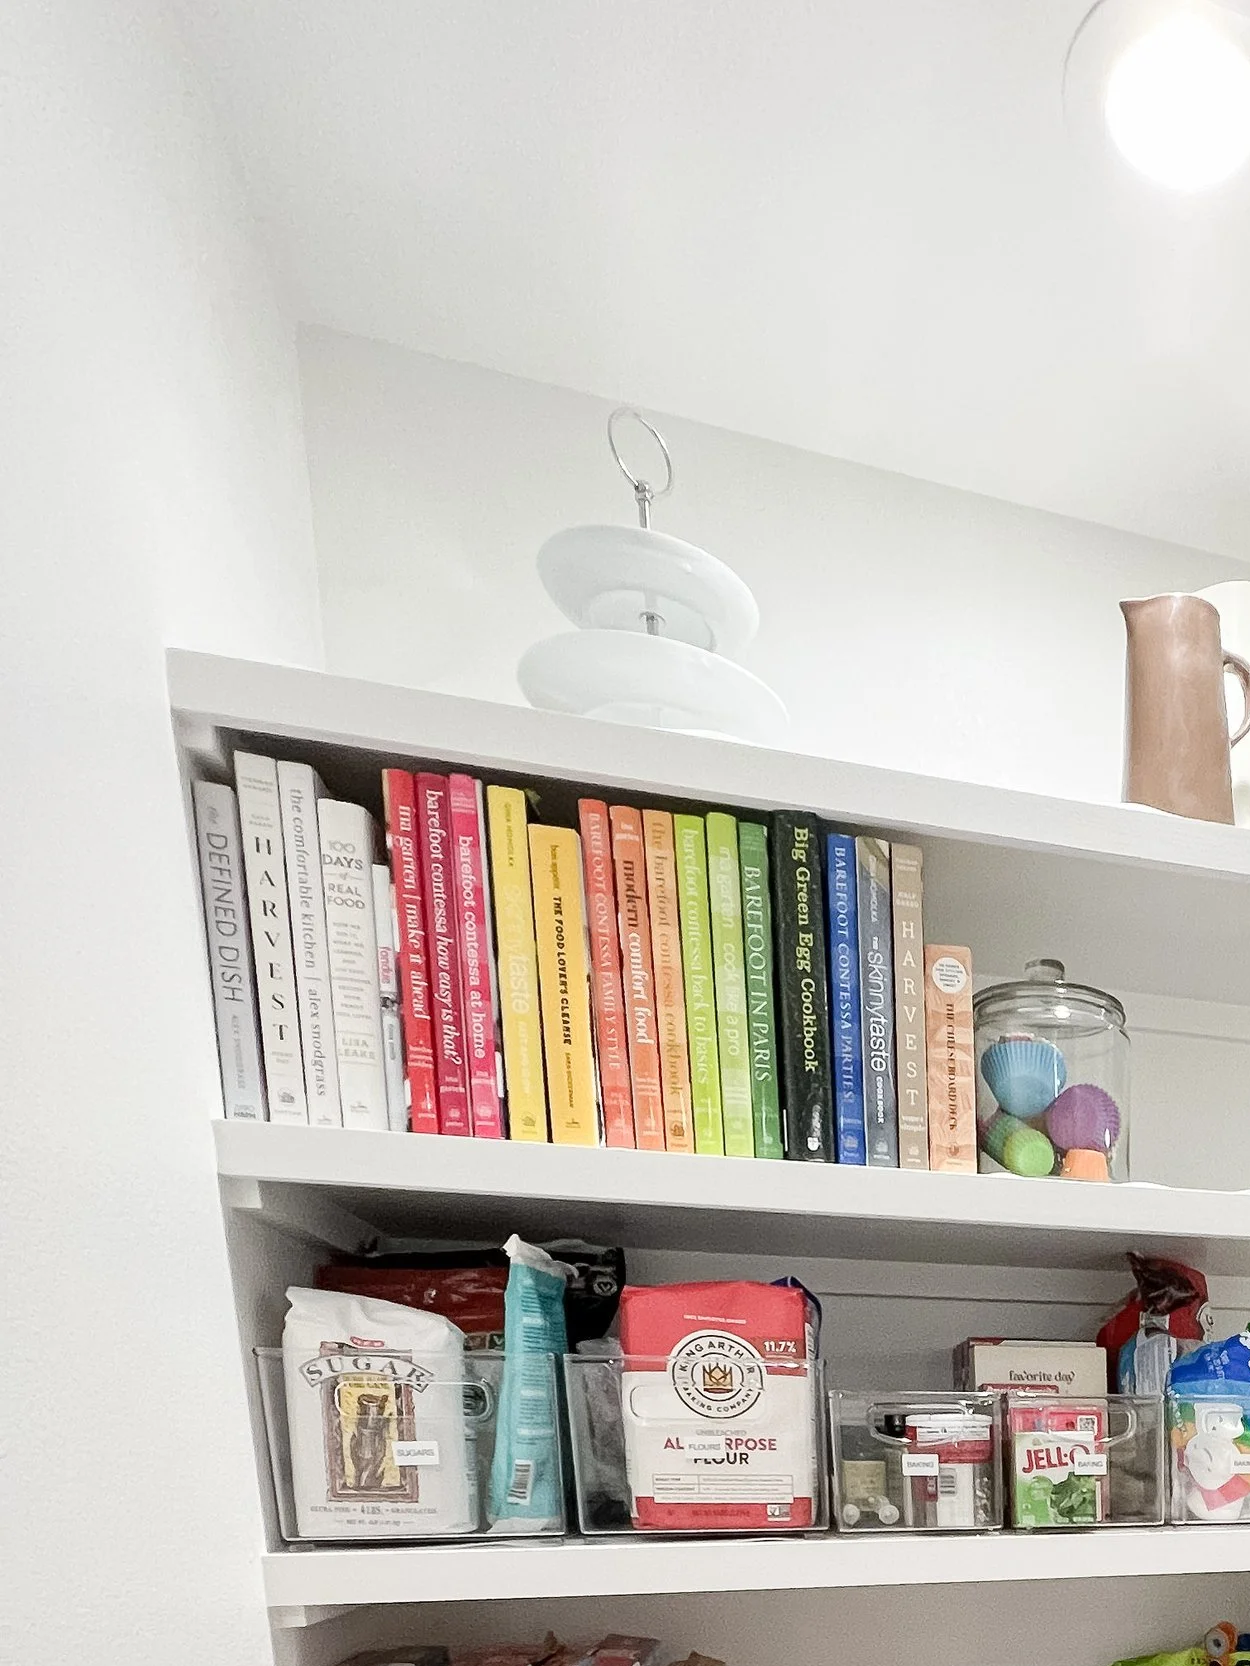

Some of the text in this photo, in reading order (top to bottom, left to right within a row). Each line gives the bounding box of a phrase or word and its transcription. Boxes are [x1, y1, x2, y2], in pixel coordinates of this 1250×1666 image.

[322, 854, 364, 871] DAYS
[589, 813, 608, 892] BAREFOOT
[681, 828, 702, 898] barefoot
[206, 832, 238, 938] DEFINED
[327, 895, 365, 910] FOOD
[328, 882, 362, 898] REAL
[552, 896, 562, 915] THE
[716, 873, 736, 929] garten
[833, 847, 850, 939] BAREFOOT
[289, 788, 327, 1096] the comfortable kitchen alex snodgrass
[404, 902, 426, 949] make
[425, 788, 463, 1066] barefoot contessa how easy is that?
[457, 835, 487, 1059] barefoot contessa at home
[554, 916, 566, 949] FOOD
[594, 894, 613, 968] CONTESSA
[686, 901, 704, 972] contessa
[791, 826, 819, 1073] Big Green Egg Cookbook
[218, 945, 244, 1004] DISH
[622, 859, 656, 1045] modern comfort food
[652, 821, 684, 1096] the barefoot contessa cookbook
[721, 942, 740, 985] cook
[744, 865, 773, 1083] BAREFOOT IN PARIS
[408, 971, 431, 1021] ahead
[601, 970, 616, 1024] FAMILY
[690, 974, 711, 1010] back
[837, 943, 853, 1029] CONTESSA
[864, 950, 889, 1072] skinnytaste
[560, 995, 572, 1046] CLEANSE
[901, 920, 920, 1106] HARVEST
[946, 1003, 956, 1023] THE
[695, 1034, 713, 1084] basics
[723, 1027, 741, 1057] pro
[305, 1356, 427, 1385] SUGAR
[679, 1341, 756, 1375] KING ARTHR
[763, 1340, 797, 1353] 11.7%
[717, 1386, 756, 1413] COMPANY
[1008, 1369, 1076, 1384] favorite day
[688, 1443, 721, 1451] FLOURS
